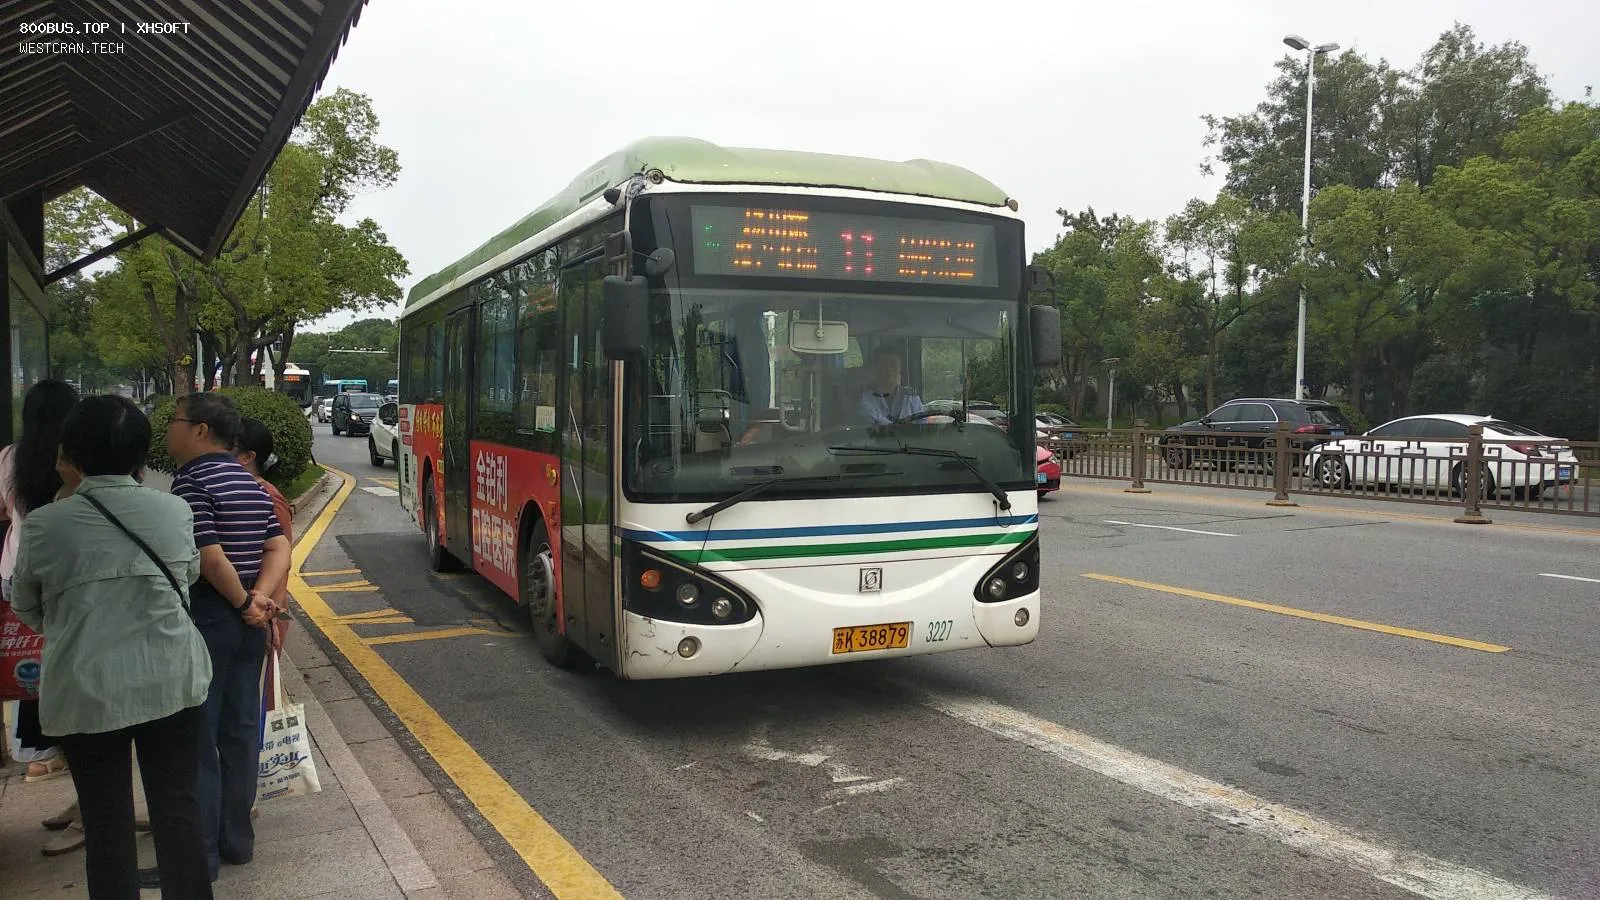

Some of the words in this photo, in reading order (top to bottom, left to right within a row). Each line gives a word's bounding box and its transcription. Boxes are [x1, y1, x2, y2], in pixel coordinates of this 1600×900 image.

[472, 508, 517, 578] 口腔医院
[925, 620, 953, 643] 3227
